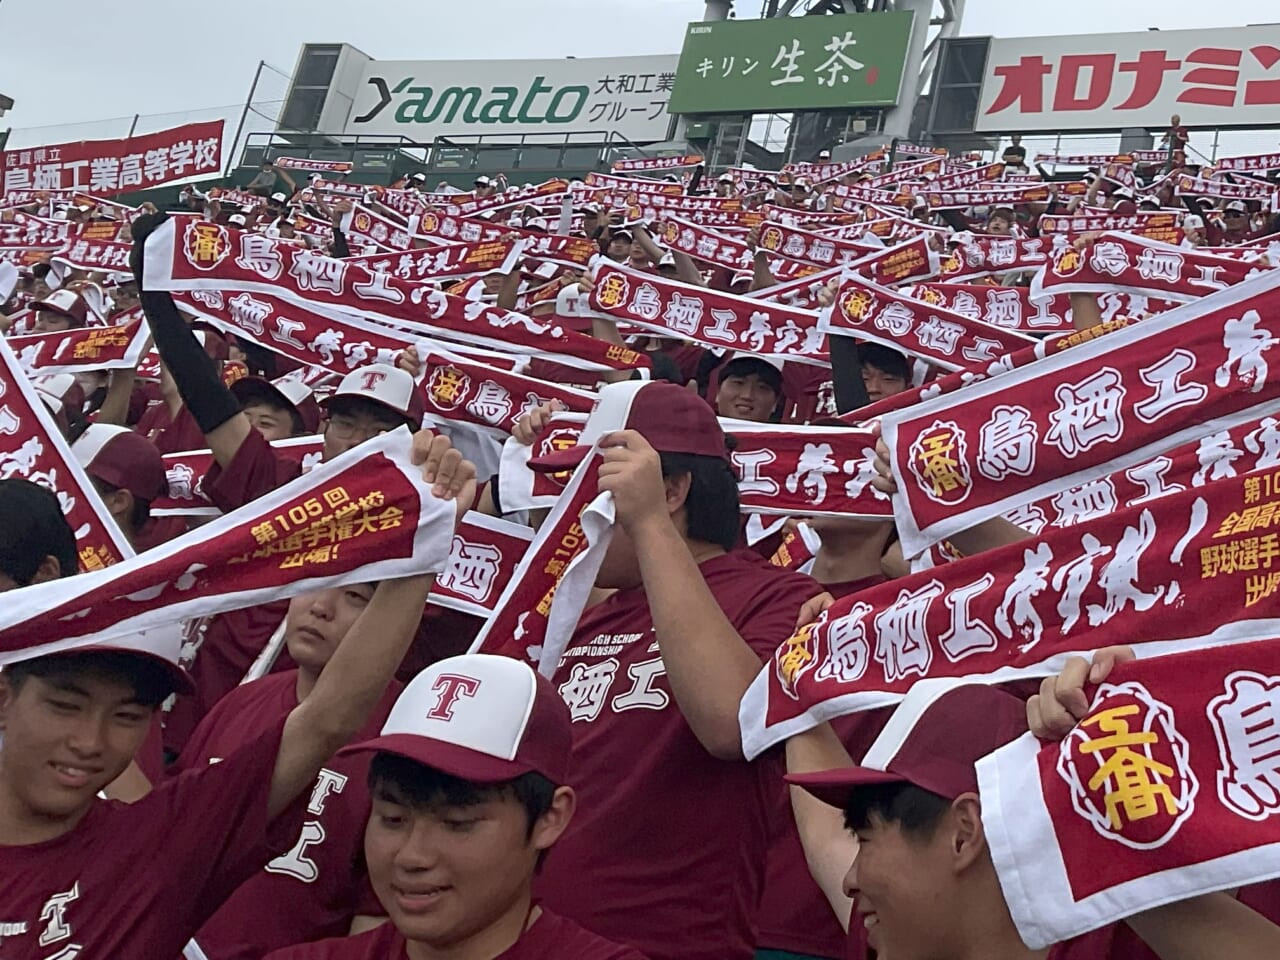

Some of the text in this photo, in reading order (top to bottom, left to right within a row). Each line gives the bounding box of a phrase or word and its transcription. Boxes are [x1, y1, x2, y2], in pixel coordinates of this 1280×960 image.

[690, 26, 712, 34] KIRIN
[695, 31, 865, 87] キリン 生茶
[354, 76, 590, 124] Yamato
[594, 72, 676, 95] 大和工業
[4, 137, 219, 192] 鳥栖工業高等学校
[6, 148, 61, 166] 佐賀県立
[566, 297, 578, 313] T
[361, 371, 387, 391] T
[250, 486, 350, 545] 第105回
[426, 672, 481, 722] T
[307, 767, 348, 815] T
